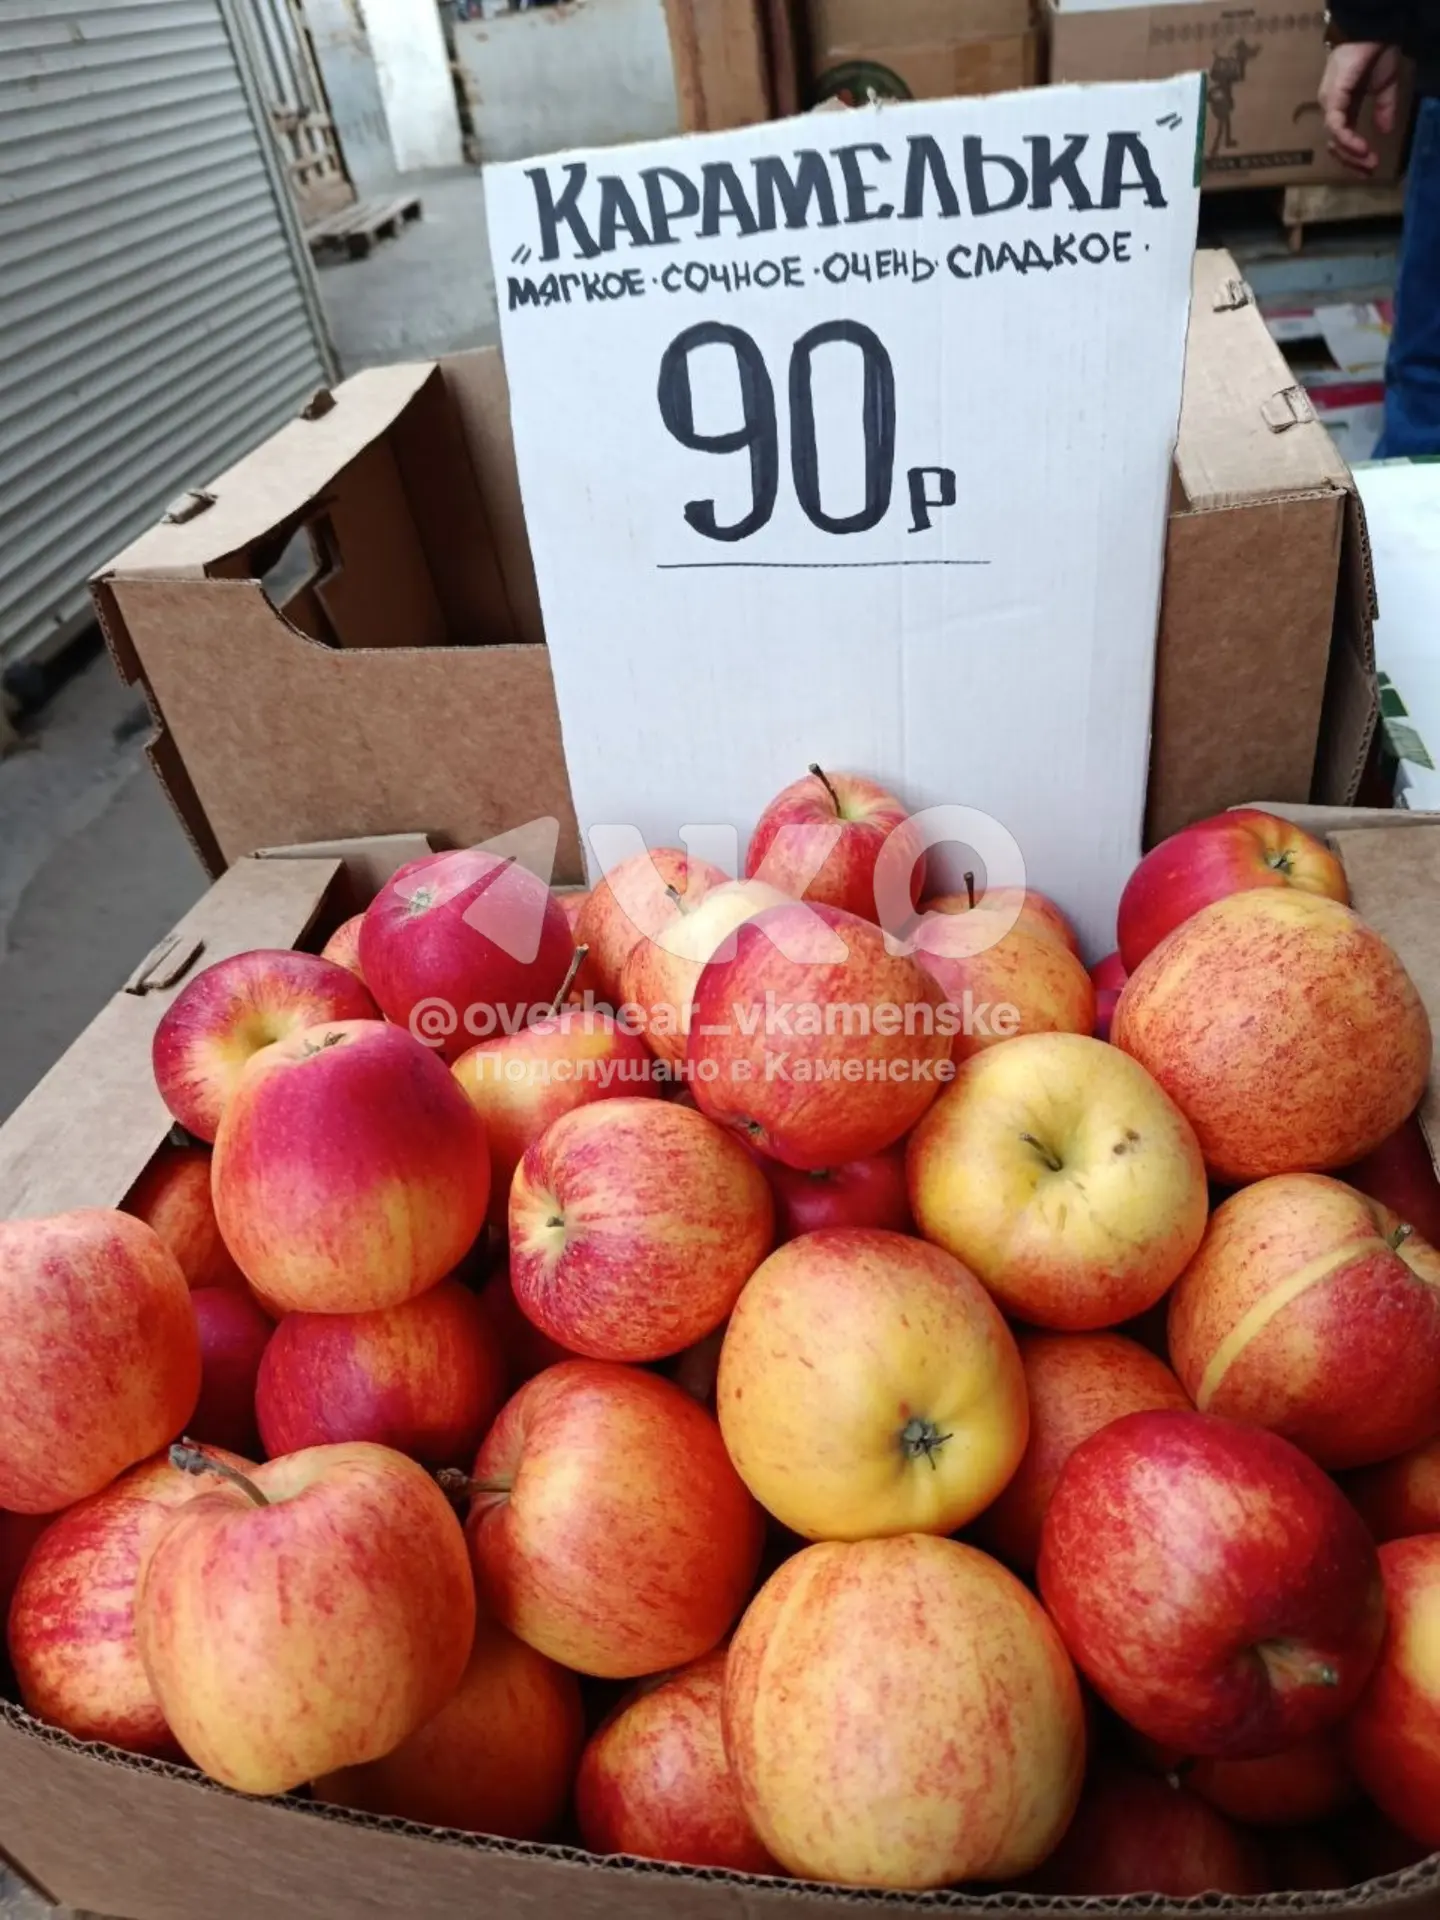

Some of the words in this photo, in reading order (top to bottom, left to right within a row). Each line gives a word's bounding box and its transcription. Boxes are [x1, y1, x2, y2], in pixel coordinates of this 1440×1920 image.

[507, 268, 645, 311] МЯГКОЕ
[661, 255, 806, 293] СОЧНОЕ
[946, 231, 1132, 279] СЛАДКОЕ
